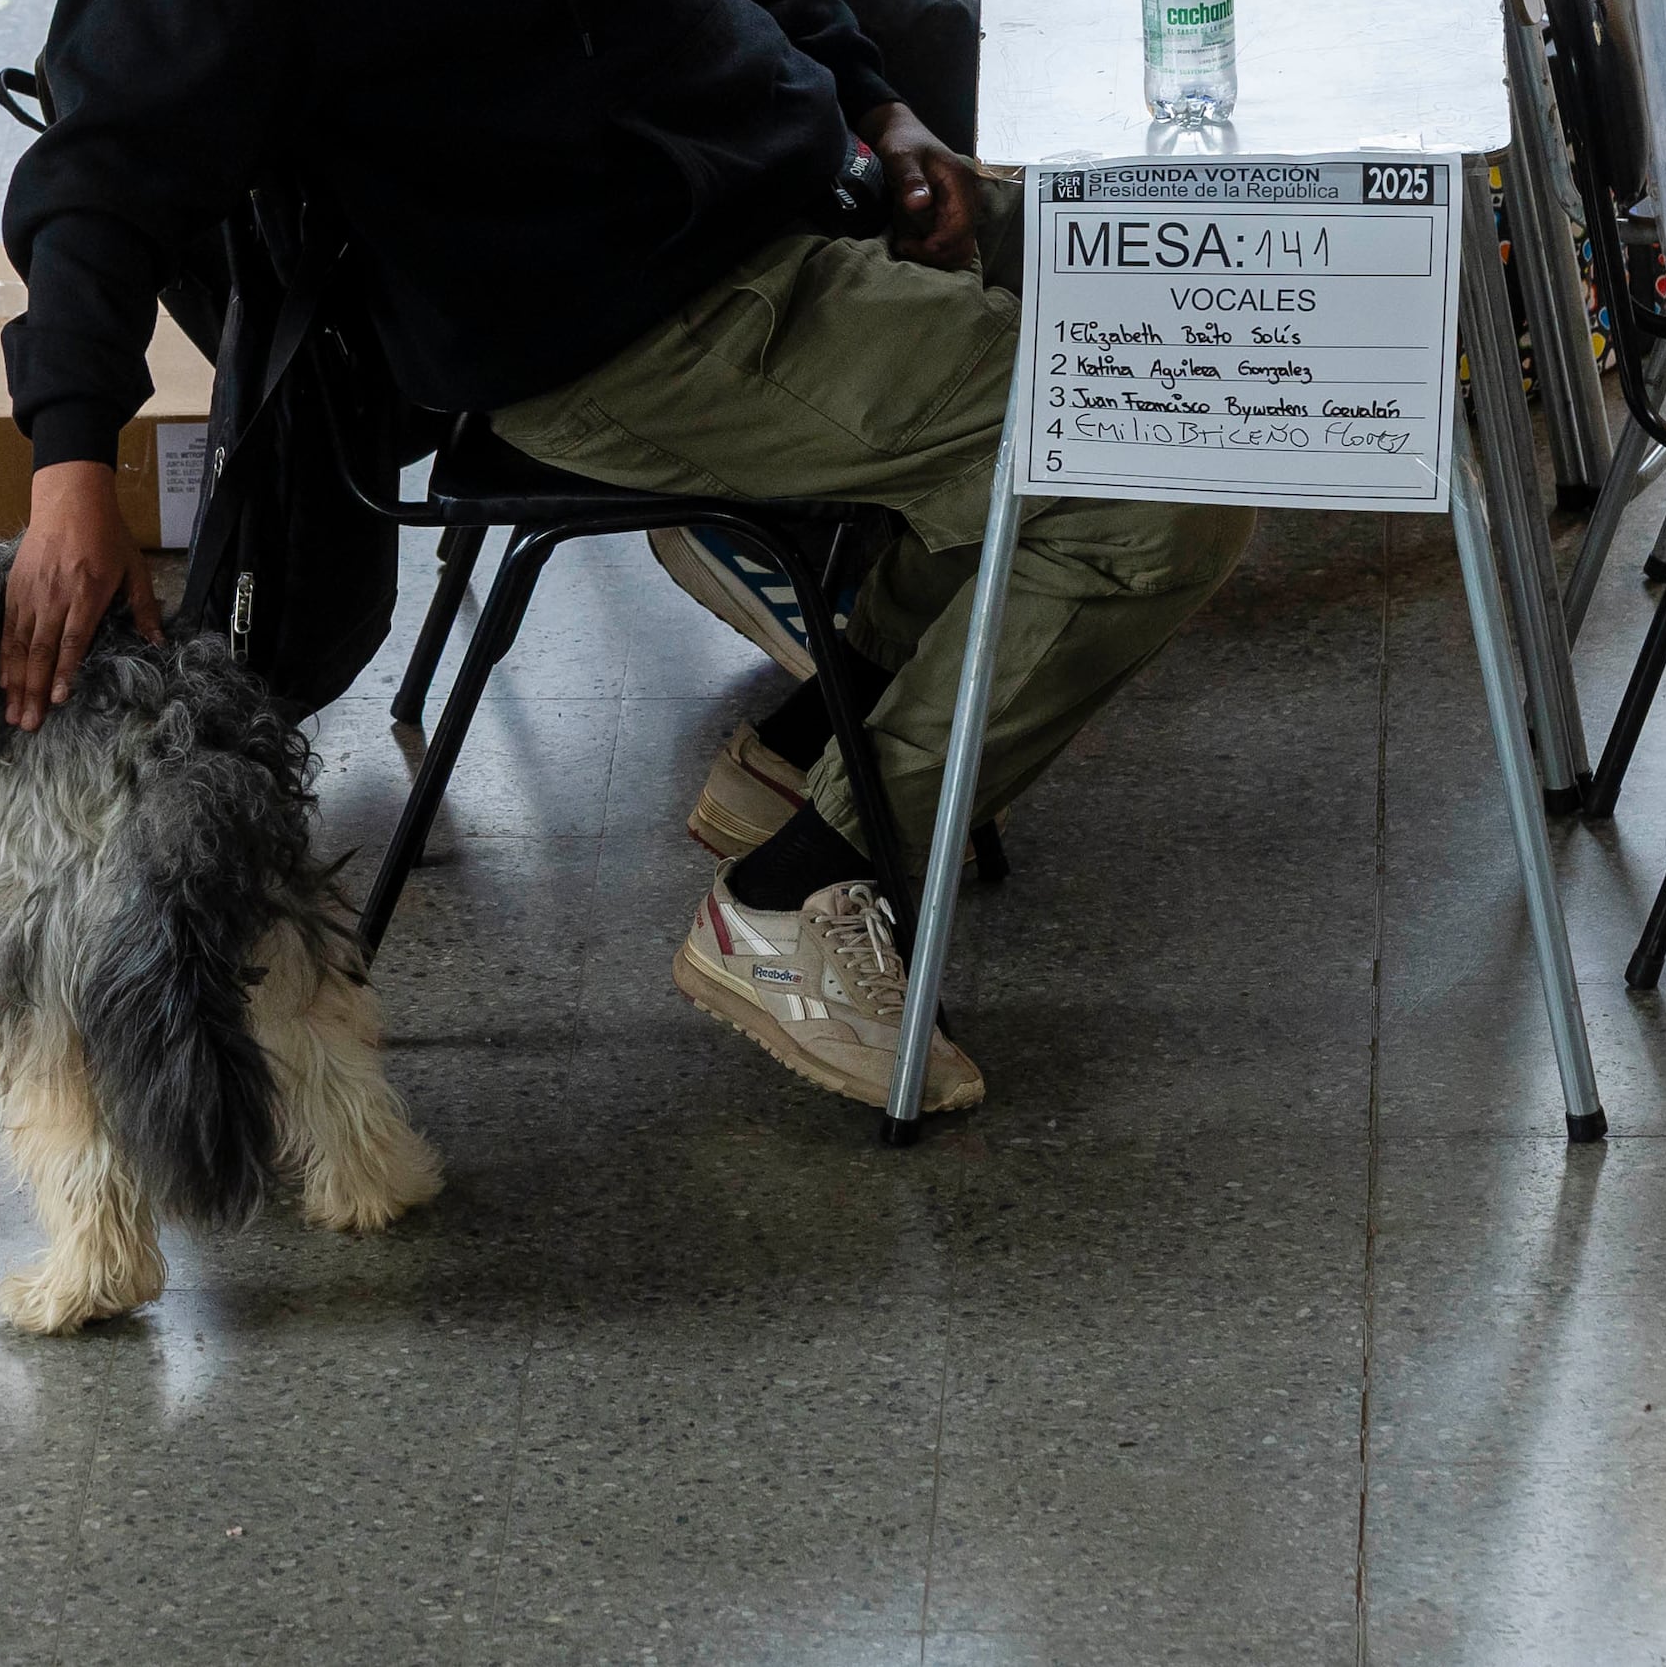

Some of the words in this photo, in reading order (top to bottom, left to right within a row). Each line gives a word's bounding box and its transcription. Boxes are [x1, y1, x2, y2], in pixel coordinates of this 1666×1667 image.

[1058, 176, 1081, 187] SER
[1088, 168, 1199, 184] SEGUNDA
[1203, 165, 1320, 183] VOTACIÓN
[1367, 167, 1429, 201] 2025
[1057, 187, 1081, 199] VEL
[1088, 184, 1188, 199] Presidente
[1194, 183, 1220, 198] de
[1223, 183, 1239, 198] la
[1246, 181, 1340, 202] República
[1067, 221, 1245, 268] MESA:
[1254, 227, 1330, 268] 141
[1170, 287, 1317, 313] VOCALES
[1054, 320, 1065, 343] 1
[1070, 321, 1163, 351] Elizabeth
[1181, 322, 1233, 345] Brito
[1251, 324, 1302, 345] Solís
[1050, 353, 1067, 376] 2
[1077, 355, 1135, 378] Katina
[1238, 360, 1313, 385] Gonzalez
[1049, 386, 1065, 408] 3
[1071, 388, 1118, 409] Juan
[1121, 392, 1211, 414] Francisco
[1046, 418, 1064, 440] 4
[1046, 450, 1063, 472] 5
[755, 966, 794, 982] Reebok
